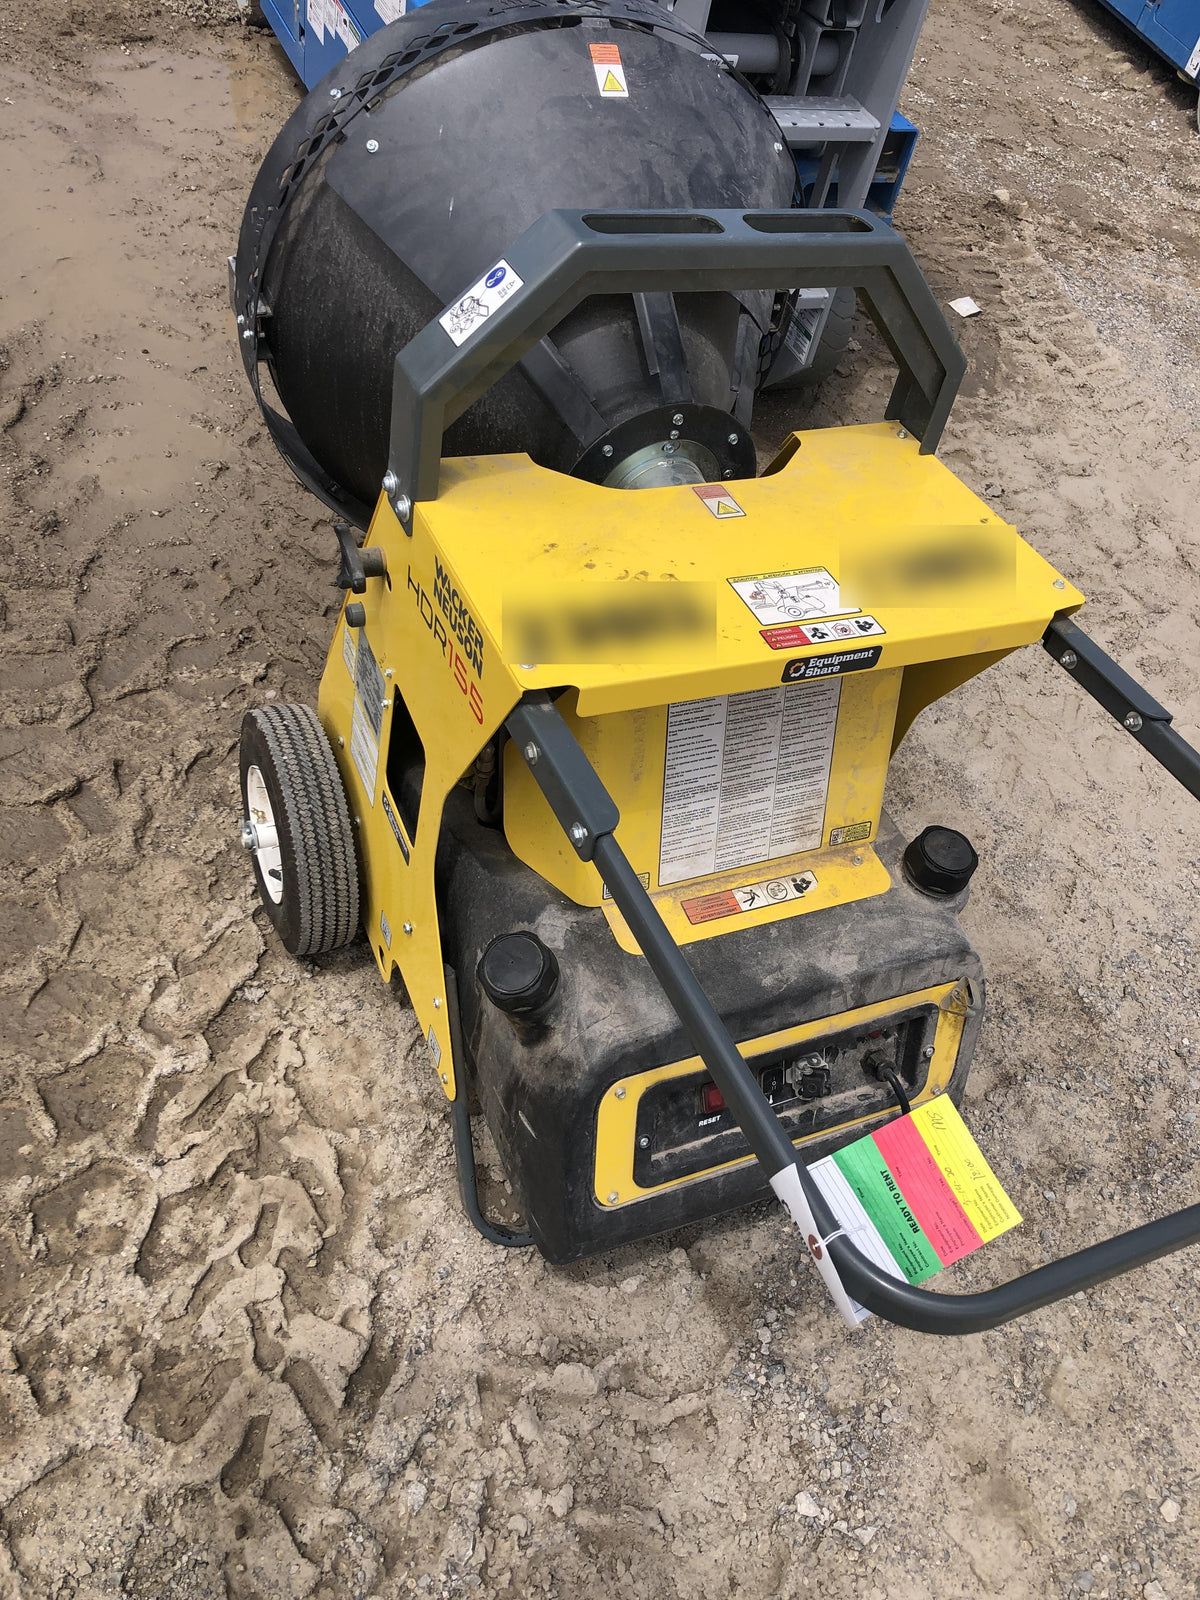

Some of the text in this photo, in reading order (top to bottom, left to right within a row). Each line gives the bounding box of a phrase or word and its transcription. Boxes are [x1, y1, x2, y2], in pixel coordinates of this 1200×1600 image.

[434, 554, 484, 660] WACKER
[433, 577, 483, 680] NEUSON
[805, 665, 840, 677] Share
[808, 649, 874, 668] Equipment
[698, 1114, 722, 1127] RESET
[879, 1168, 920, 1233] READY TO RENT
